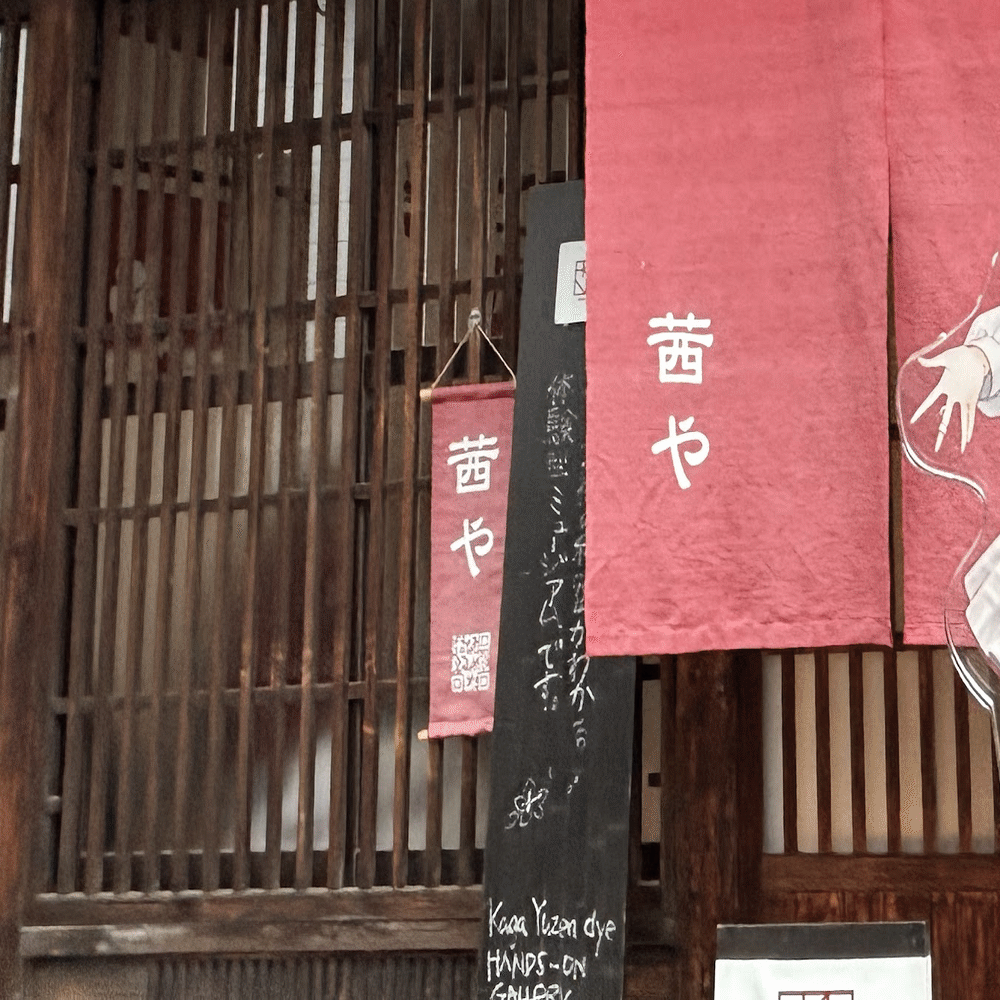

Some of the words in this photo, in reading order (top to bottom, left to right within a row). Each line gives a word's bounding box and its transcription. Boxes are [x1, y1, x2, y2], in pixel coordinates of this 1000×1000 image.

[647, 312, 713, 489] 茜や
[447, 434, 500, 578] 茜や
[486, 948, 587, 982] HANDS-ON
[532, 896, 577, 939] Yuzen
[583, 909, 617, 957] dye
